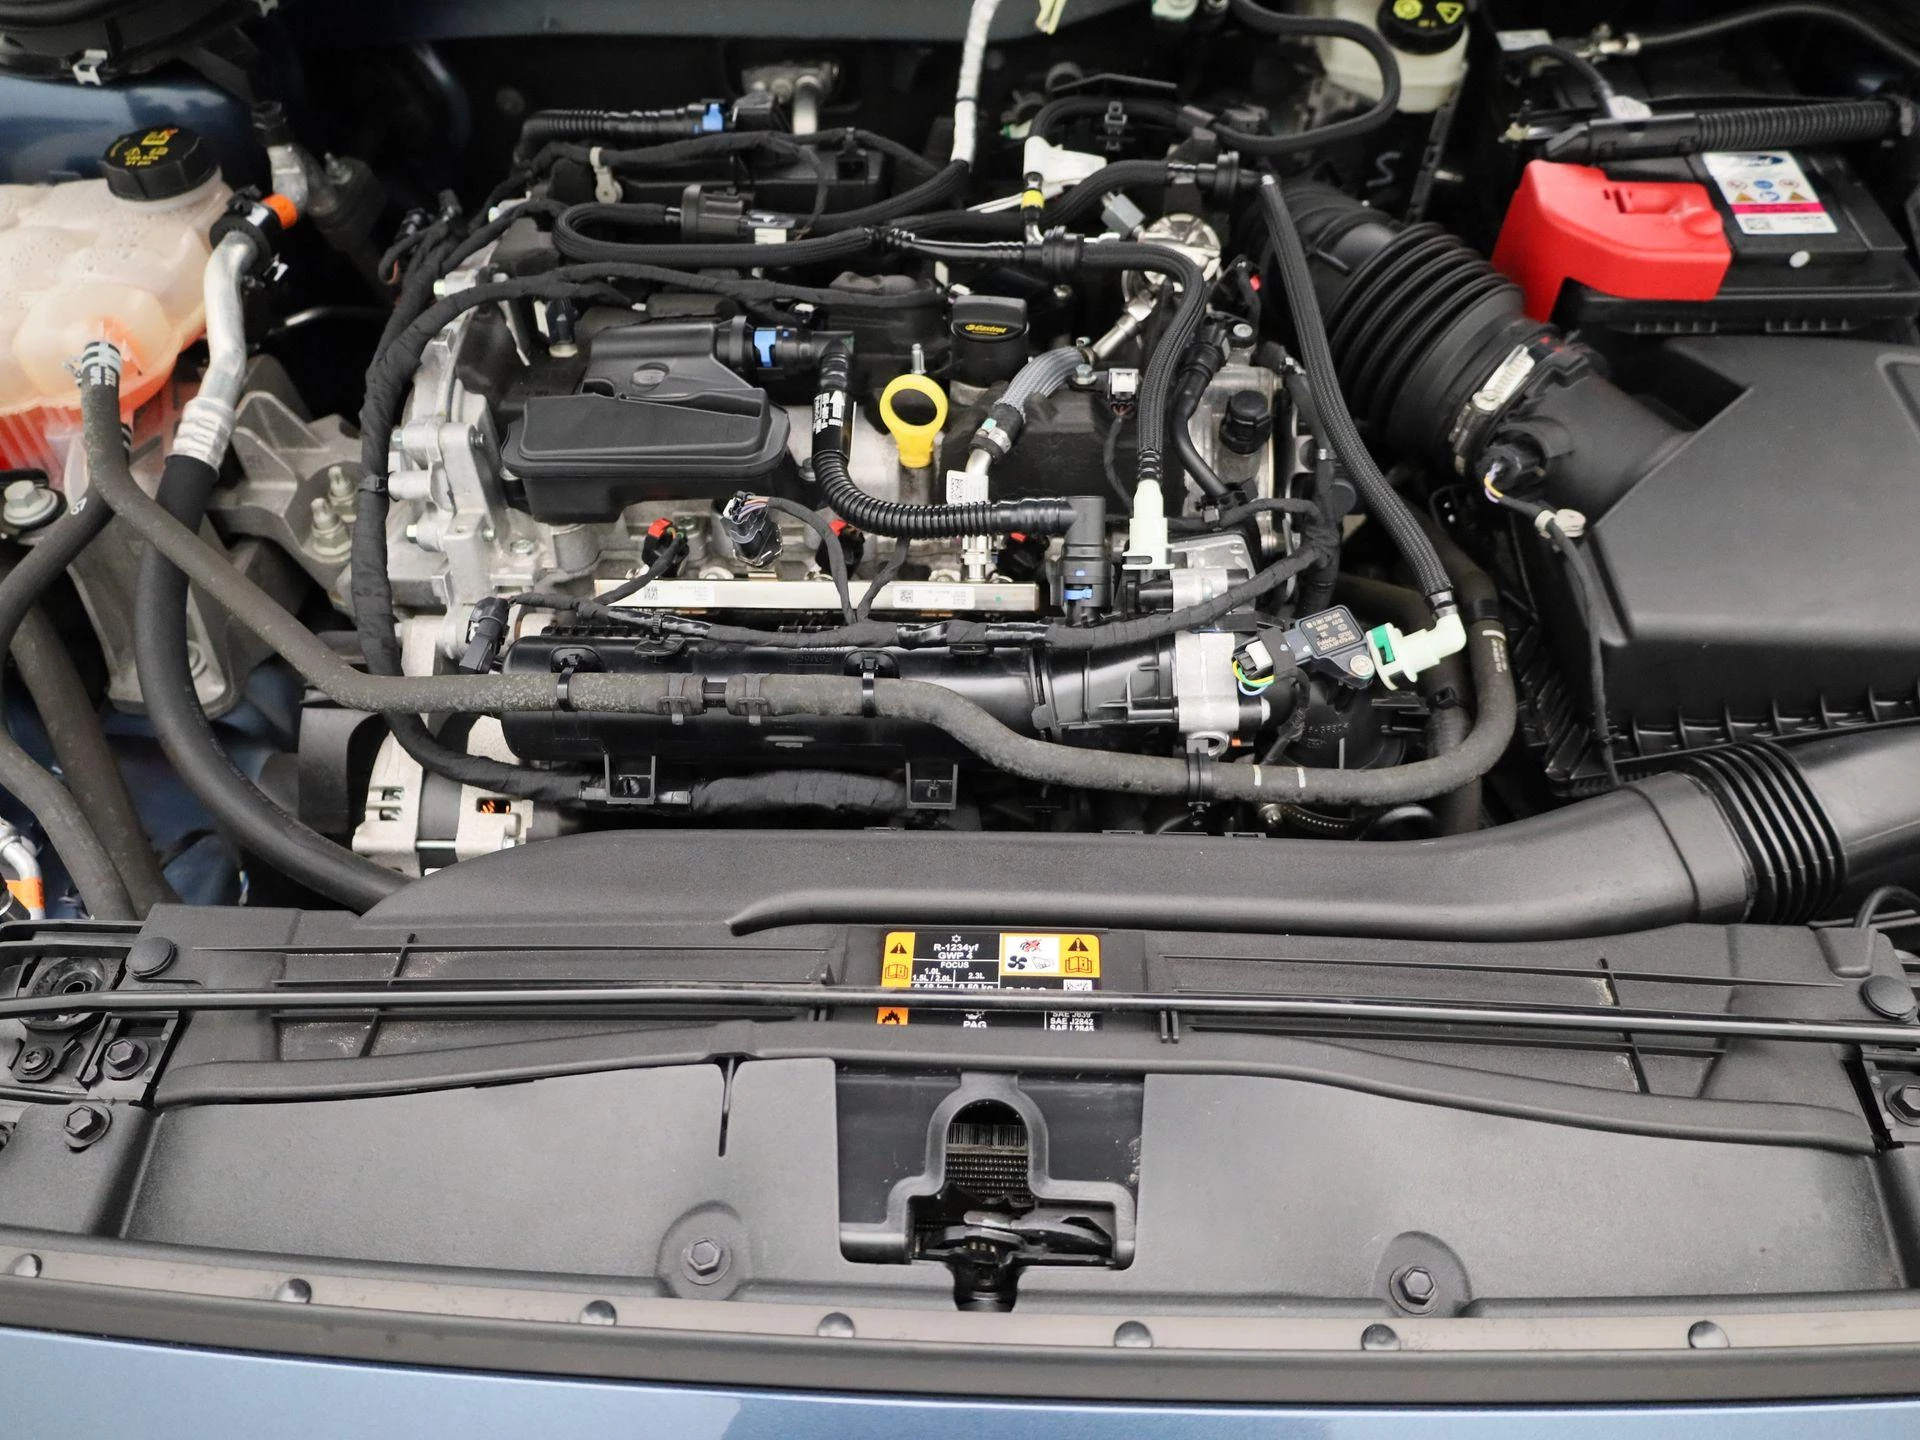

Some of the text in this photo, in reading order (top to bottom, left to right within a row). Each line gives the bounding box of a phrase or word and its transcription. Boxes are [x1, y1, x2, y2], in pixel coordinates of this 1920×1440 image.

[975, 325, 1007, 334] Castrol
[933, 943, 980, 953] R-1234yf
[937, 951, 973, 960] GWP 4
[940, 961, 970, 969] FOCUS
[924, 967, 941, 975] 1.0L
[912, 974, 929, 982] 1.5L
[967, 972, 985, 980] 2.3L
[963, 1020, 987, 1028] PAG
[1050, 1017, 1067, 1025] SAE
